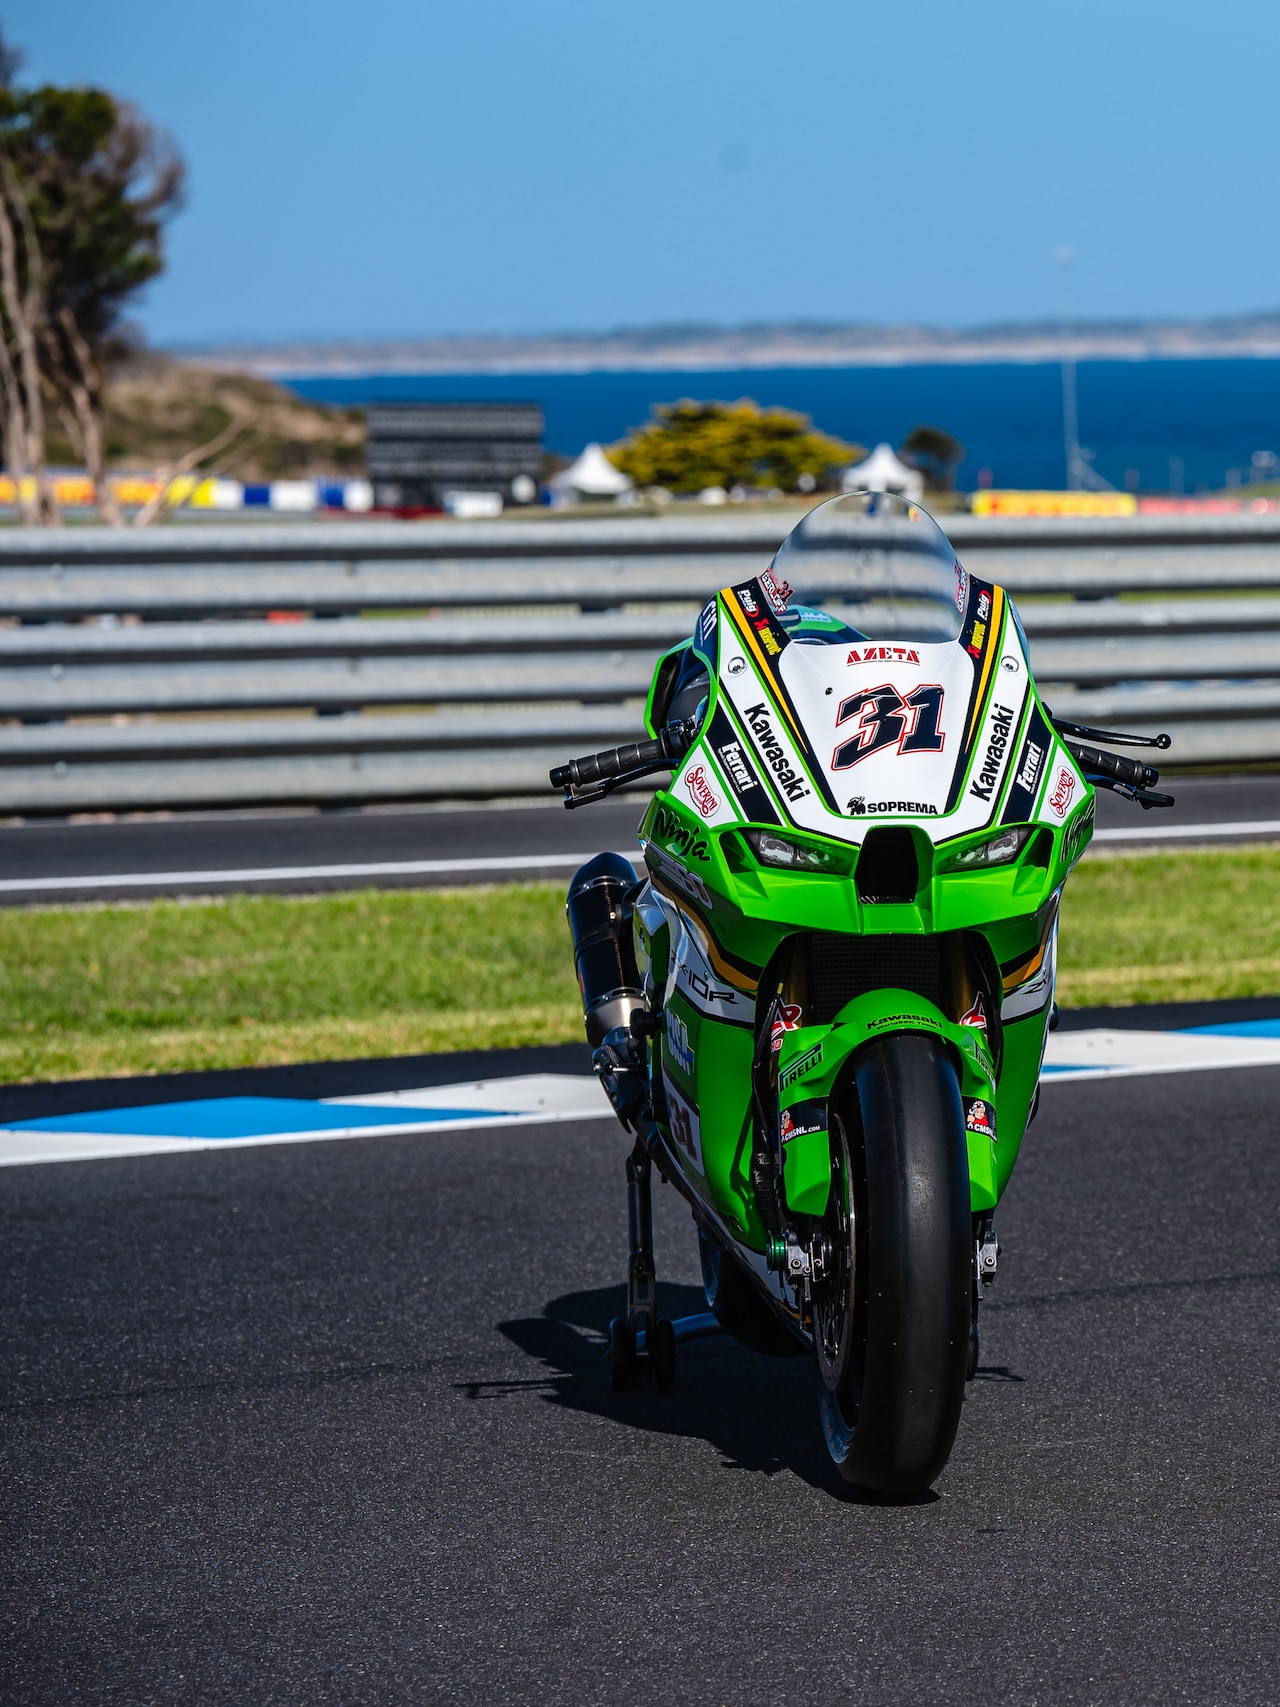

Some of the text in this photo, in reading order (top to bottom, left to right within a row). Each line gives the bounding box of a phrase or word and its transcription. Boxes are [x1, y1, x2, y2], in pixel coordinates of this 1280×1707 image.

[737, 588, 757, 613] Puig
[977, 593, 990, 620] Puig
[847, 647, 920, 664] AZETA
[743, 702, 811, 802] Kawasaki
[831, 683, 946, 771] 31
[721, 741, 759, 792] Ferrari
[969, 703, 1015, 803] Kawasaki
[1016, 740, 1042, 792] Ferrari
[867, 801, 939, 815] SOPREMA
[653, 808, 712, 861] Ninja
[866, 1014, 943, 1030] Kawasaki
[779, 1043, 823, 1093] PIRELLI
